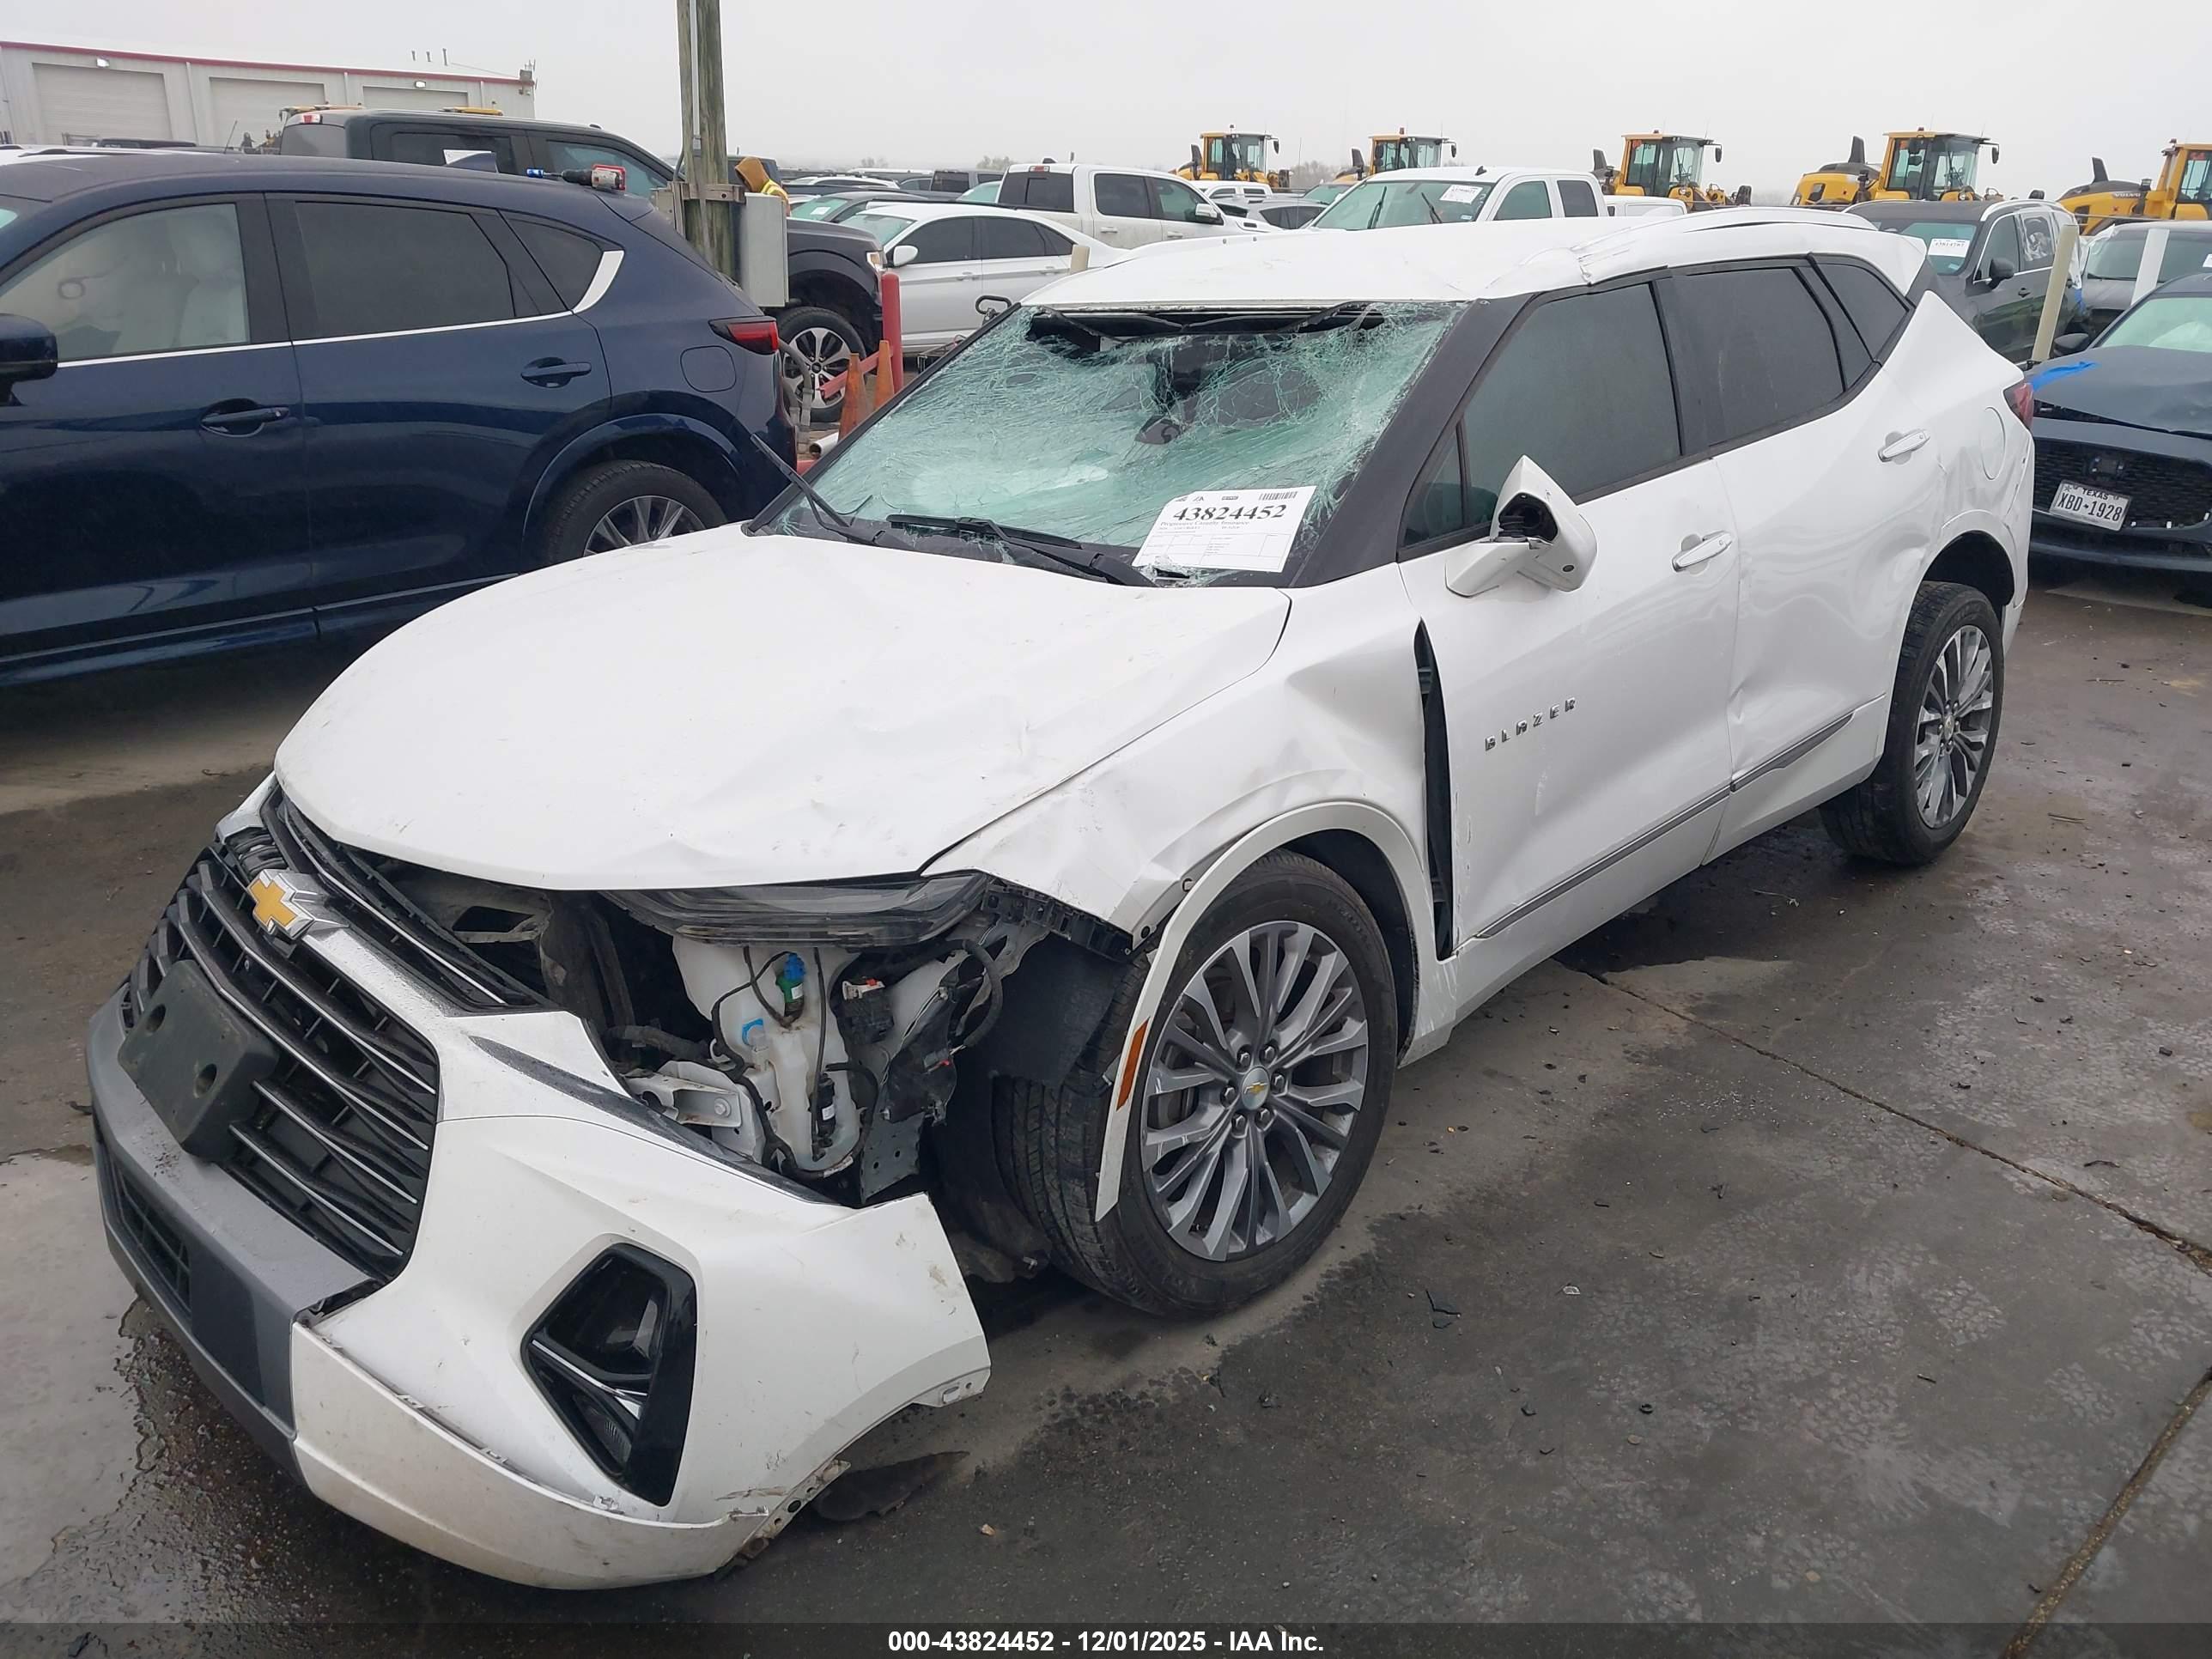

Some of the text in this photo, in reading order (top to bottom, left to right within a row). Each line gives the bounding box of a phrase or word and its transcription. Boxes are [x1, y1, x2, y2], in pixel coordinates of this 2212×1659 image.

[2081, 488, 2108, 500] TEXAS
[1174, 504, 1287, 520] 43824452
[1485, 697, 1576, 751] BLAZER
